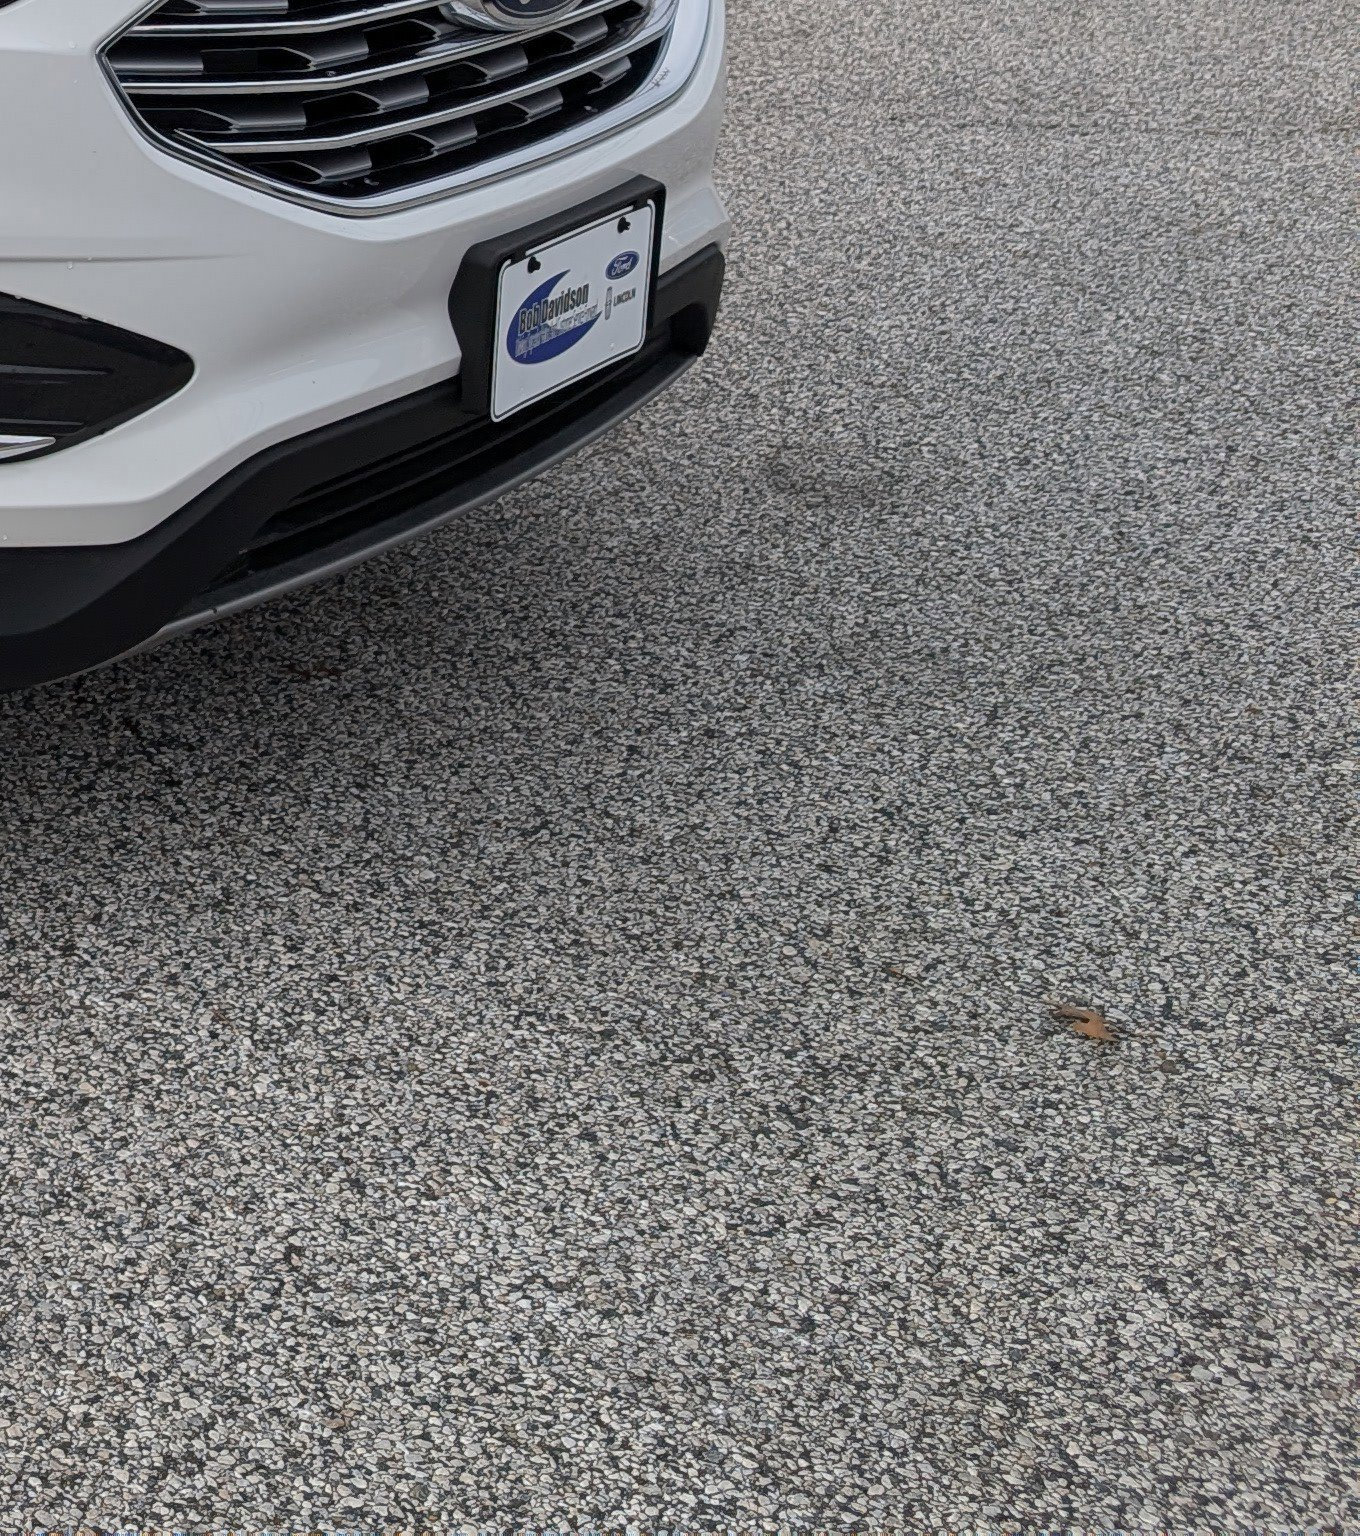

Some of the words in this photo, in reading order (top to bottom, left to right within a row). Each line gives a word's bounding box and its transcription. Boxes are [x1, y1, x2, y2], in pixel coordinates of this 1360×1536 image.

[610, 255, 635, 276] Ford
[518, 301, 541, 336] Bob
[540, 282, 590, 324] Davidson
